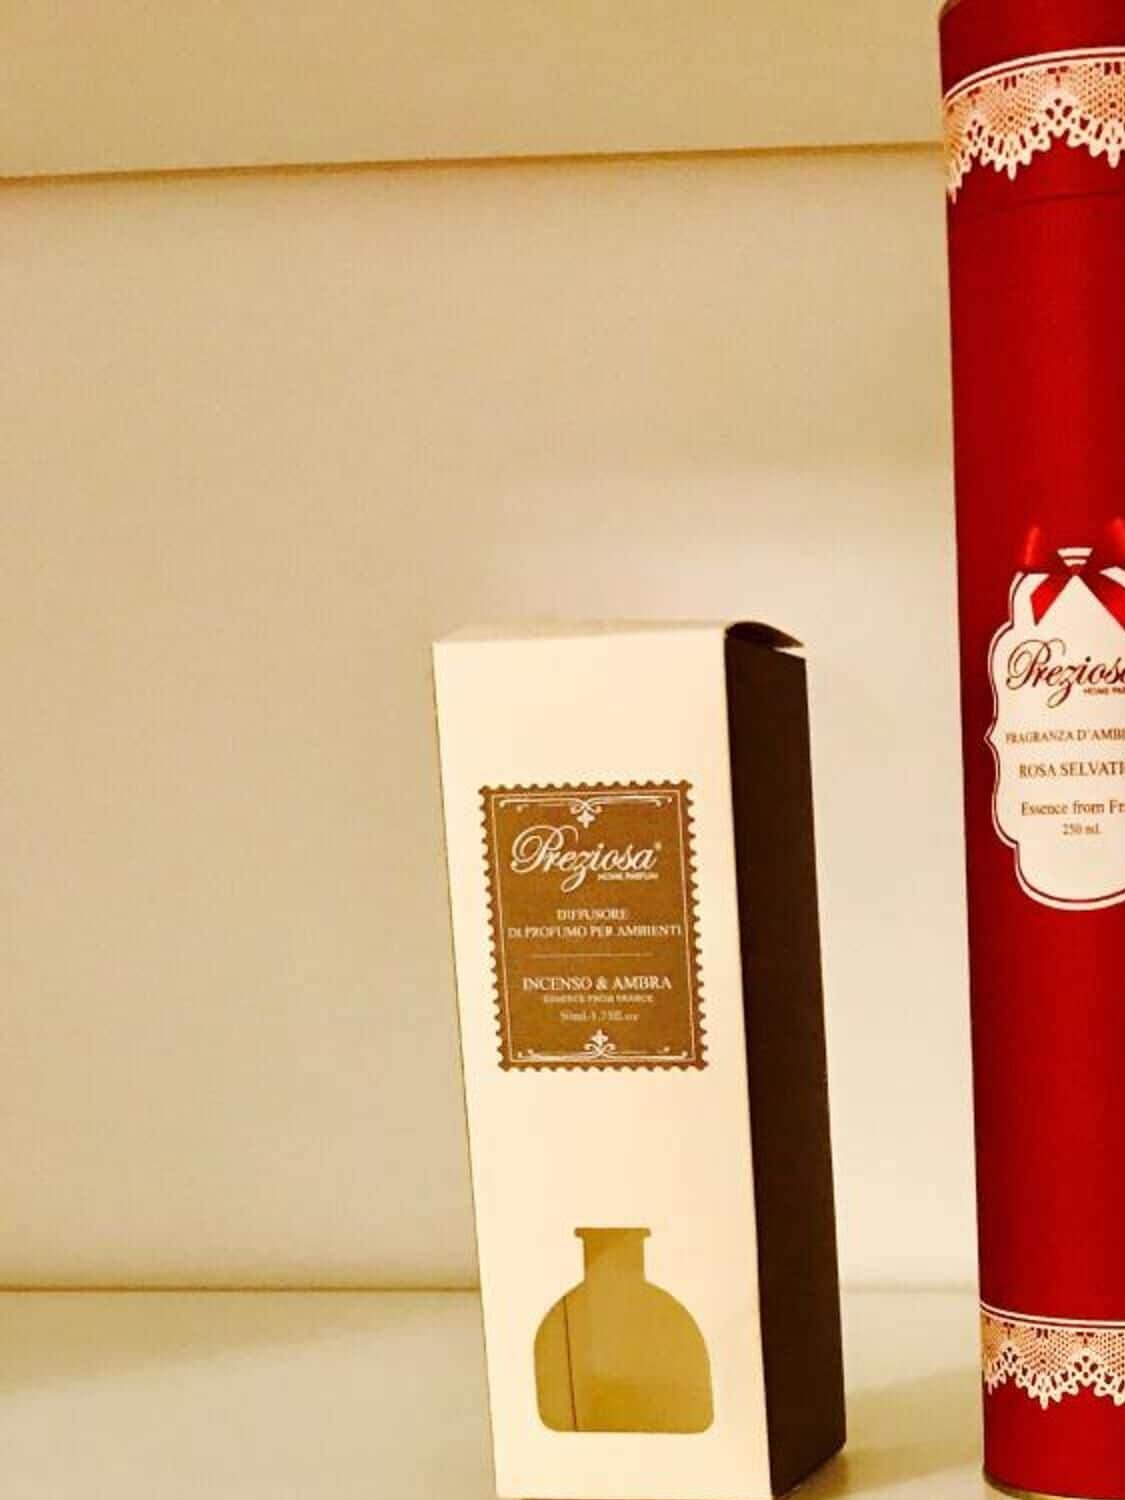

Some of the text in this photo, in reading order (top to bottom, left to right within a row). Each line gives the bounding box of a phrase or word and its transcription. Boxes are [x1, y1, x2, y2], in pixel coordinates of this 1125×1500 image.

[1006, 730, 1073, 744] FRAGRANZA
[1019, 763, 1057, 778] ROSA
[1021, 801, 1068, 816] Essence
[1073, 800, 1105, 814] from
[511, 824, 658, 892] Preziosa
[556, 908, 628, 920] DIFFUSORE
[525, 926, 587, 938] PROFUMO
[590, 925, 613, 937] PER
[614, 924, 682, 937] AMBIENTI
[523, 975, 673, 991] INCENSO & AMBRA
